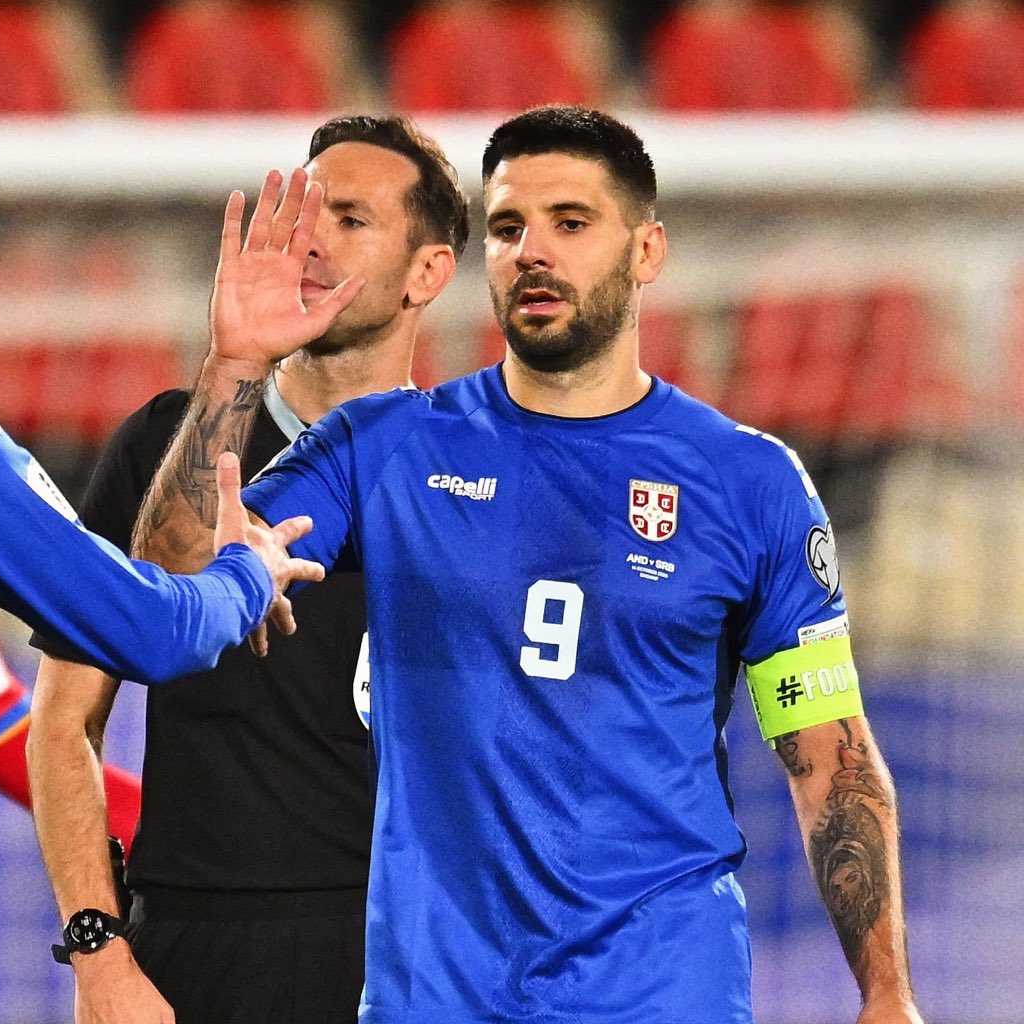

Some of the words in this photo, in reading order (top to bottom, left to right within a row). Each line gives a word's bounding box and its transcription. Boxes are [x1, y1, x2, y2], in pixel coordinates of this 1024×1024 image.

[427, 474, 497, 494] capelli
[454, 488, 494, 501] SPORT
[626, 553, 648, 566] AND
[655, 559, 675, 573] SRB
[519, 579, 585, 681] 9
